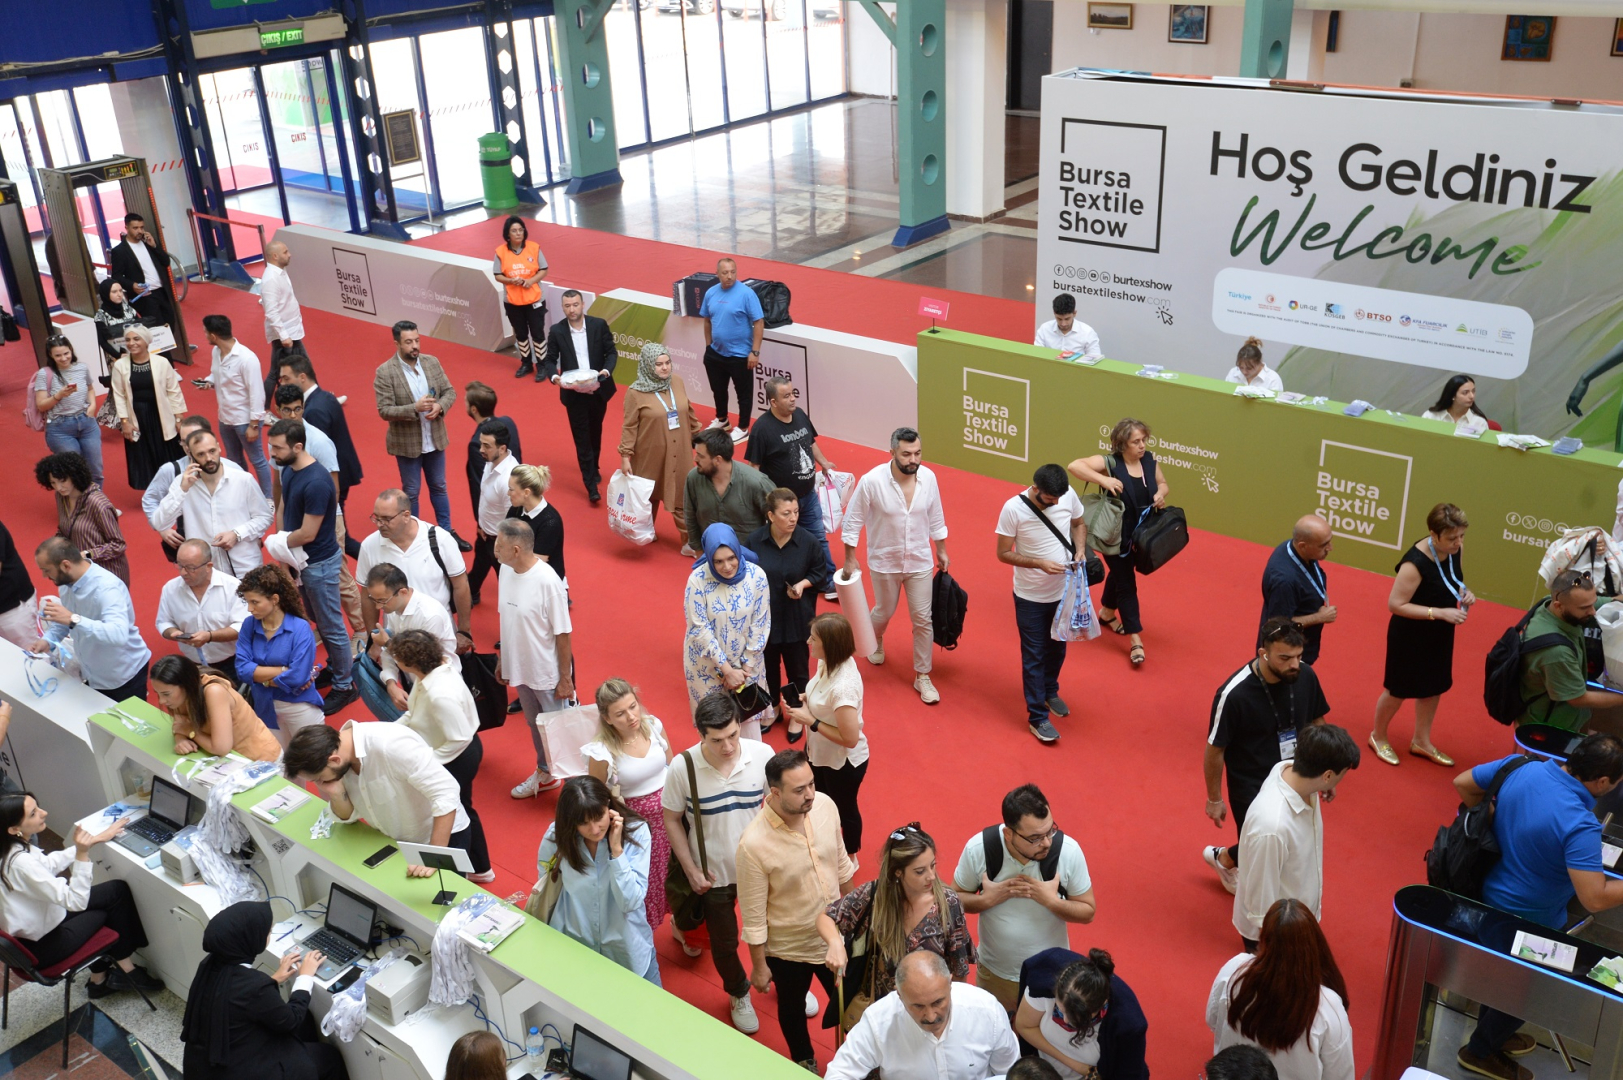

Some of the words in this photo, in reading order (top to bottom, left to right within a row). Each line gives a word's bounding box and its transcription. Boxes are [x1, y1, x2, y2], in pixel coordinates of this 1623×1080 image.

[261, 32, 281, 47] ÇIKIŞ
[286, 30, 304, 41] EXIT
[1060, 160, 1131, 188] Bursa
[1210, 130, 1314, 198] Hoş
[1338, 142, 1598, 214] Geldiniz
[1059, 186, 1144, 216] Textile
[1058, 210, 1128, 238] Show
[1230, 192, 1542, 280] Welcome
[336, 268, 361, 283] Bursa
[1113, 274, 1172, 291] burtexshow
[338, 281, 368, 297] Textile
[341, 293, 365, 308] Show
[1053, 280, 1172, 308] bursatextileshow.com
[1228, 291, 1252, 301] Türkiye
[1300, 303, 1317, 312] UR-GE
[1367, 312, 1392, 322] BTSO
[756, 362, 792, 382] Bursa
[963, 394, 1009, 419] Bursa
[963, 411, 1018, 436] Textile
[963, 427, 1008, 450] Show
[1159, 438, 1219, 460] burtexshow
[1316, 471, 1380, 500] Bursa
[1316, 490, 1390, 521] Textile
[1315, 507, 1375, 536] Show
